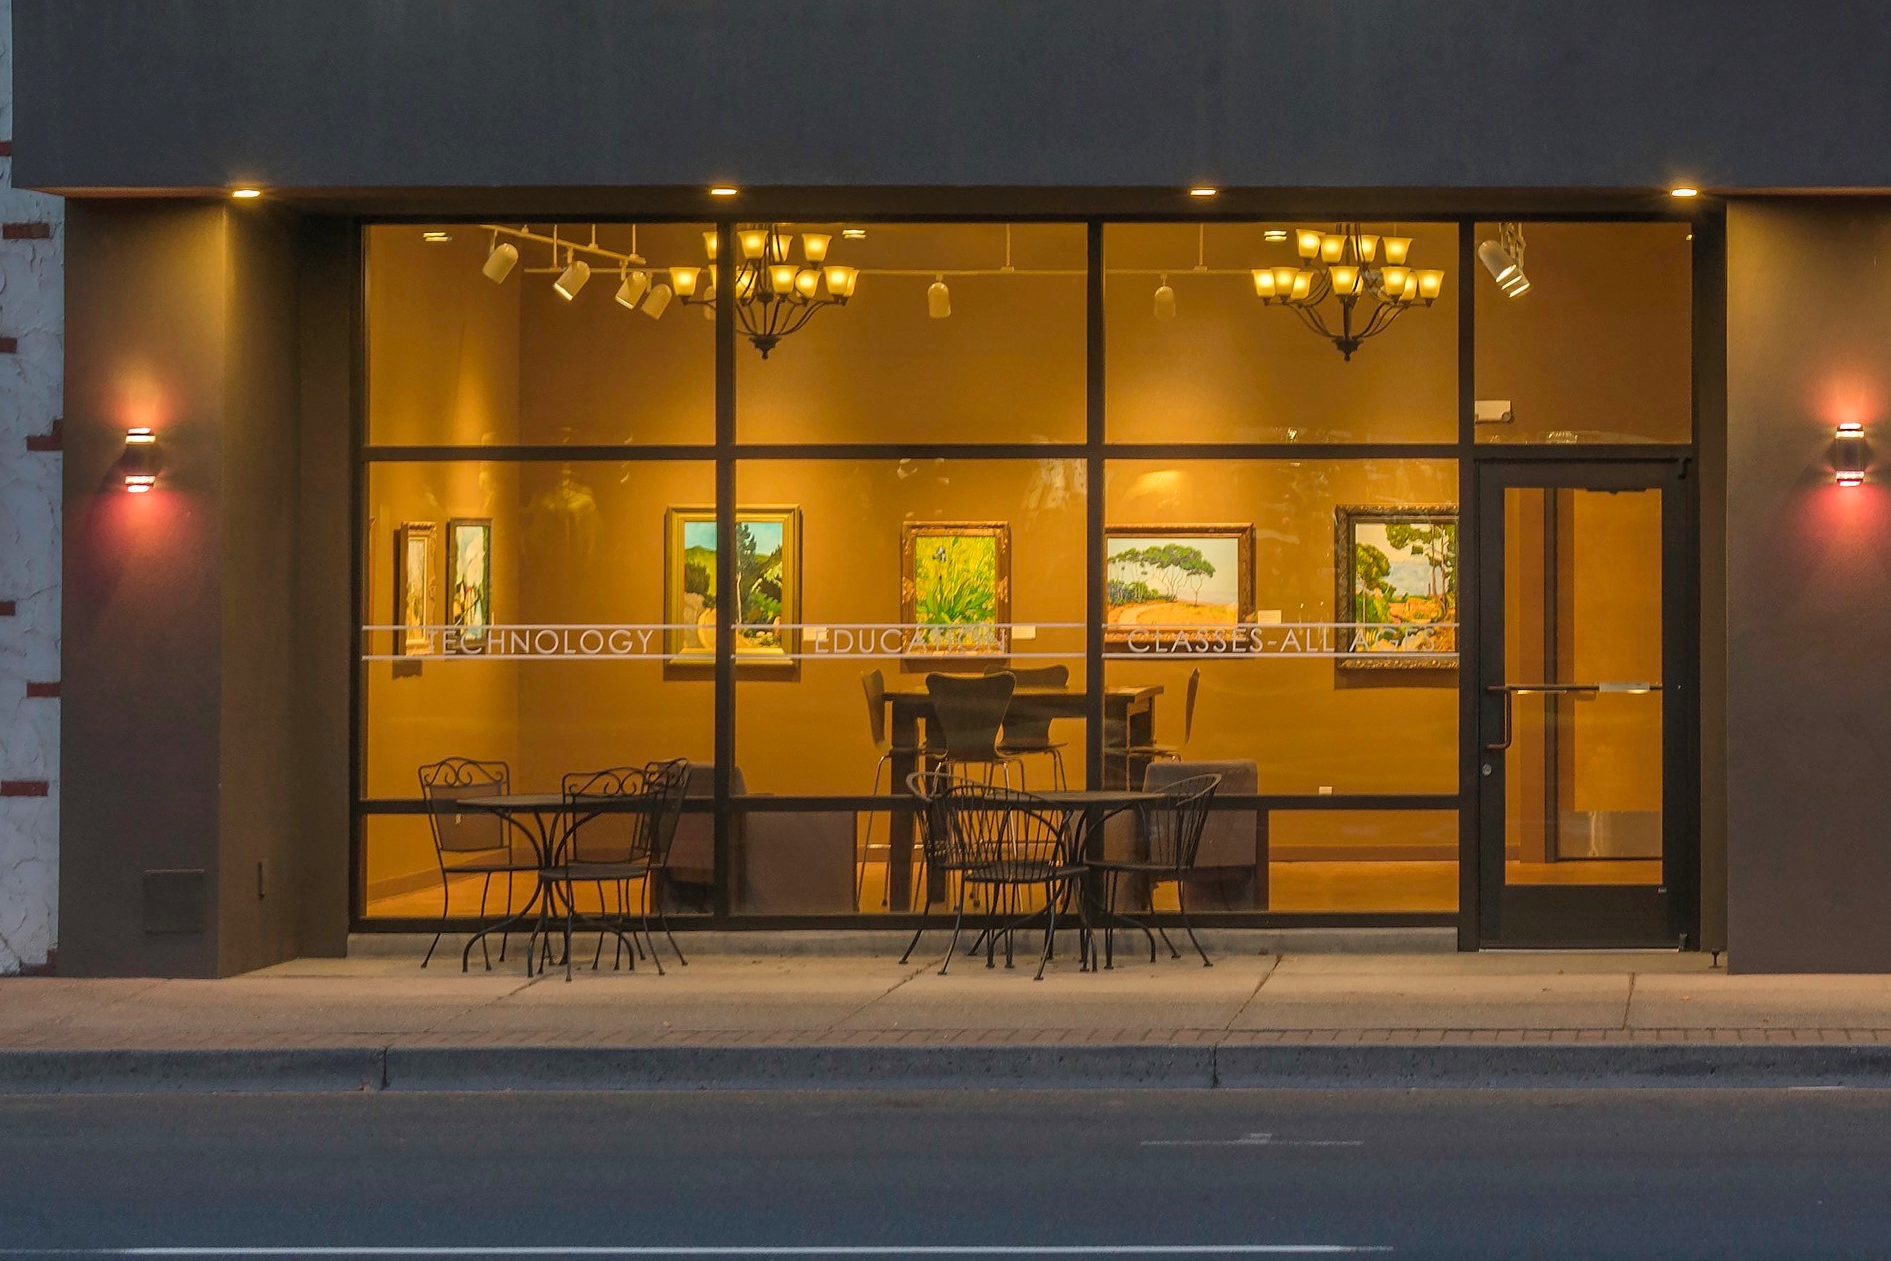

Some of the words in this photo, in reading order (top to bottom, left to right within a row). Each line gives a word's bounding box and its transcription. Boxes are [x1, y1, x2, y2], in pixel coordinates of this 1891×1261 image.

[425, 629, 653, 655] TECHNOLOGY
[815, 628, 1006, 654] EDUCATION
[1349, 627, 1436, 653] AGES
